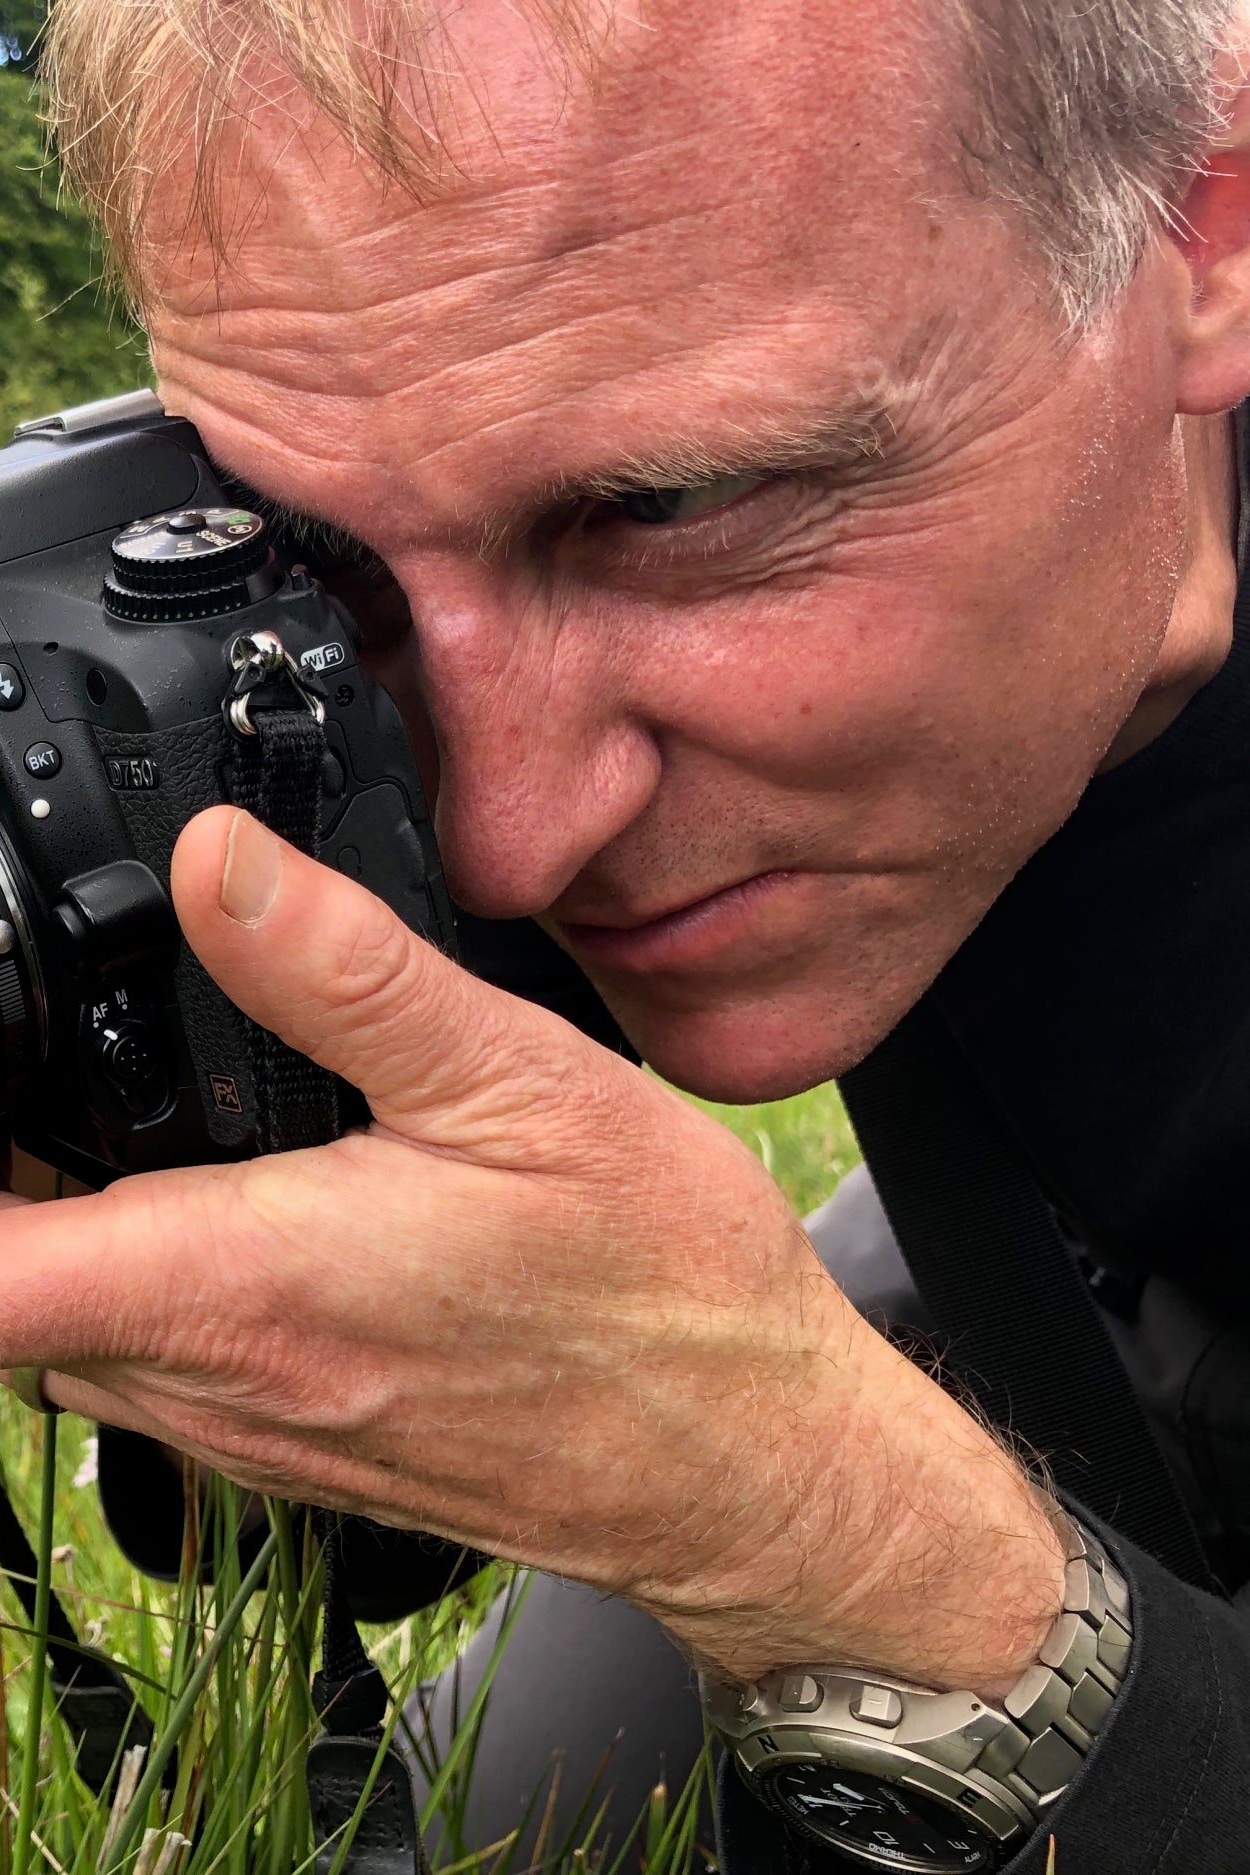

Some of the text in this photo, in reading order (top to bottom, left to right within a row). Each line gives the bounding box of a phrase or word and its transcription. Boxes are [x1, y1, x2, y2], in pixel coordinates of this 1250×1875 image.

[195, 530, 232, 547] SCENE
[28, 750, 55, 771] BKT
[109, 760, 154, 787] D750
[92, 989, 128, 1021] AF M
[757, 1735, 779, 1754] N
[872, 1830, 900, 1845] 10
[868, 1842, 906, 1860] THERMO
